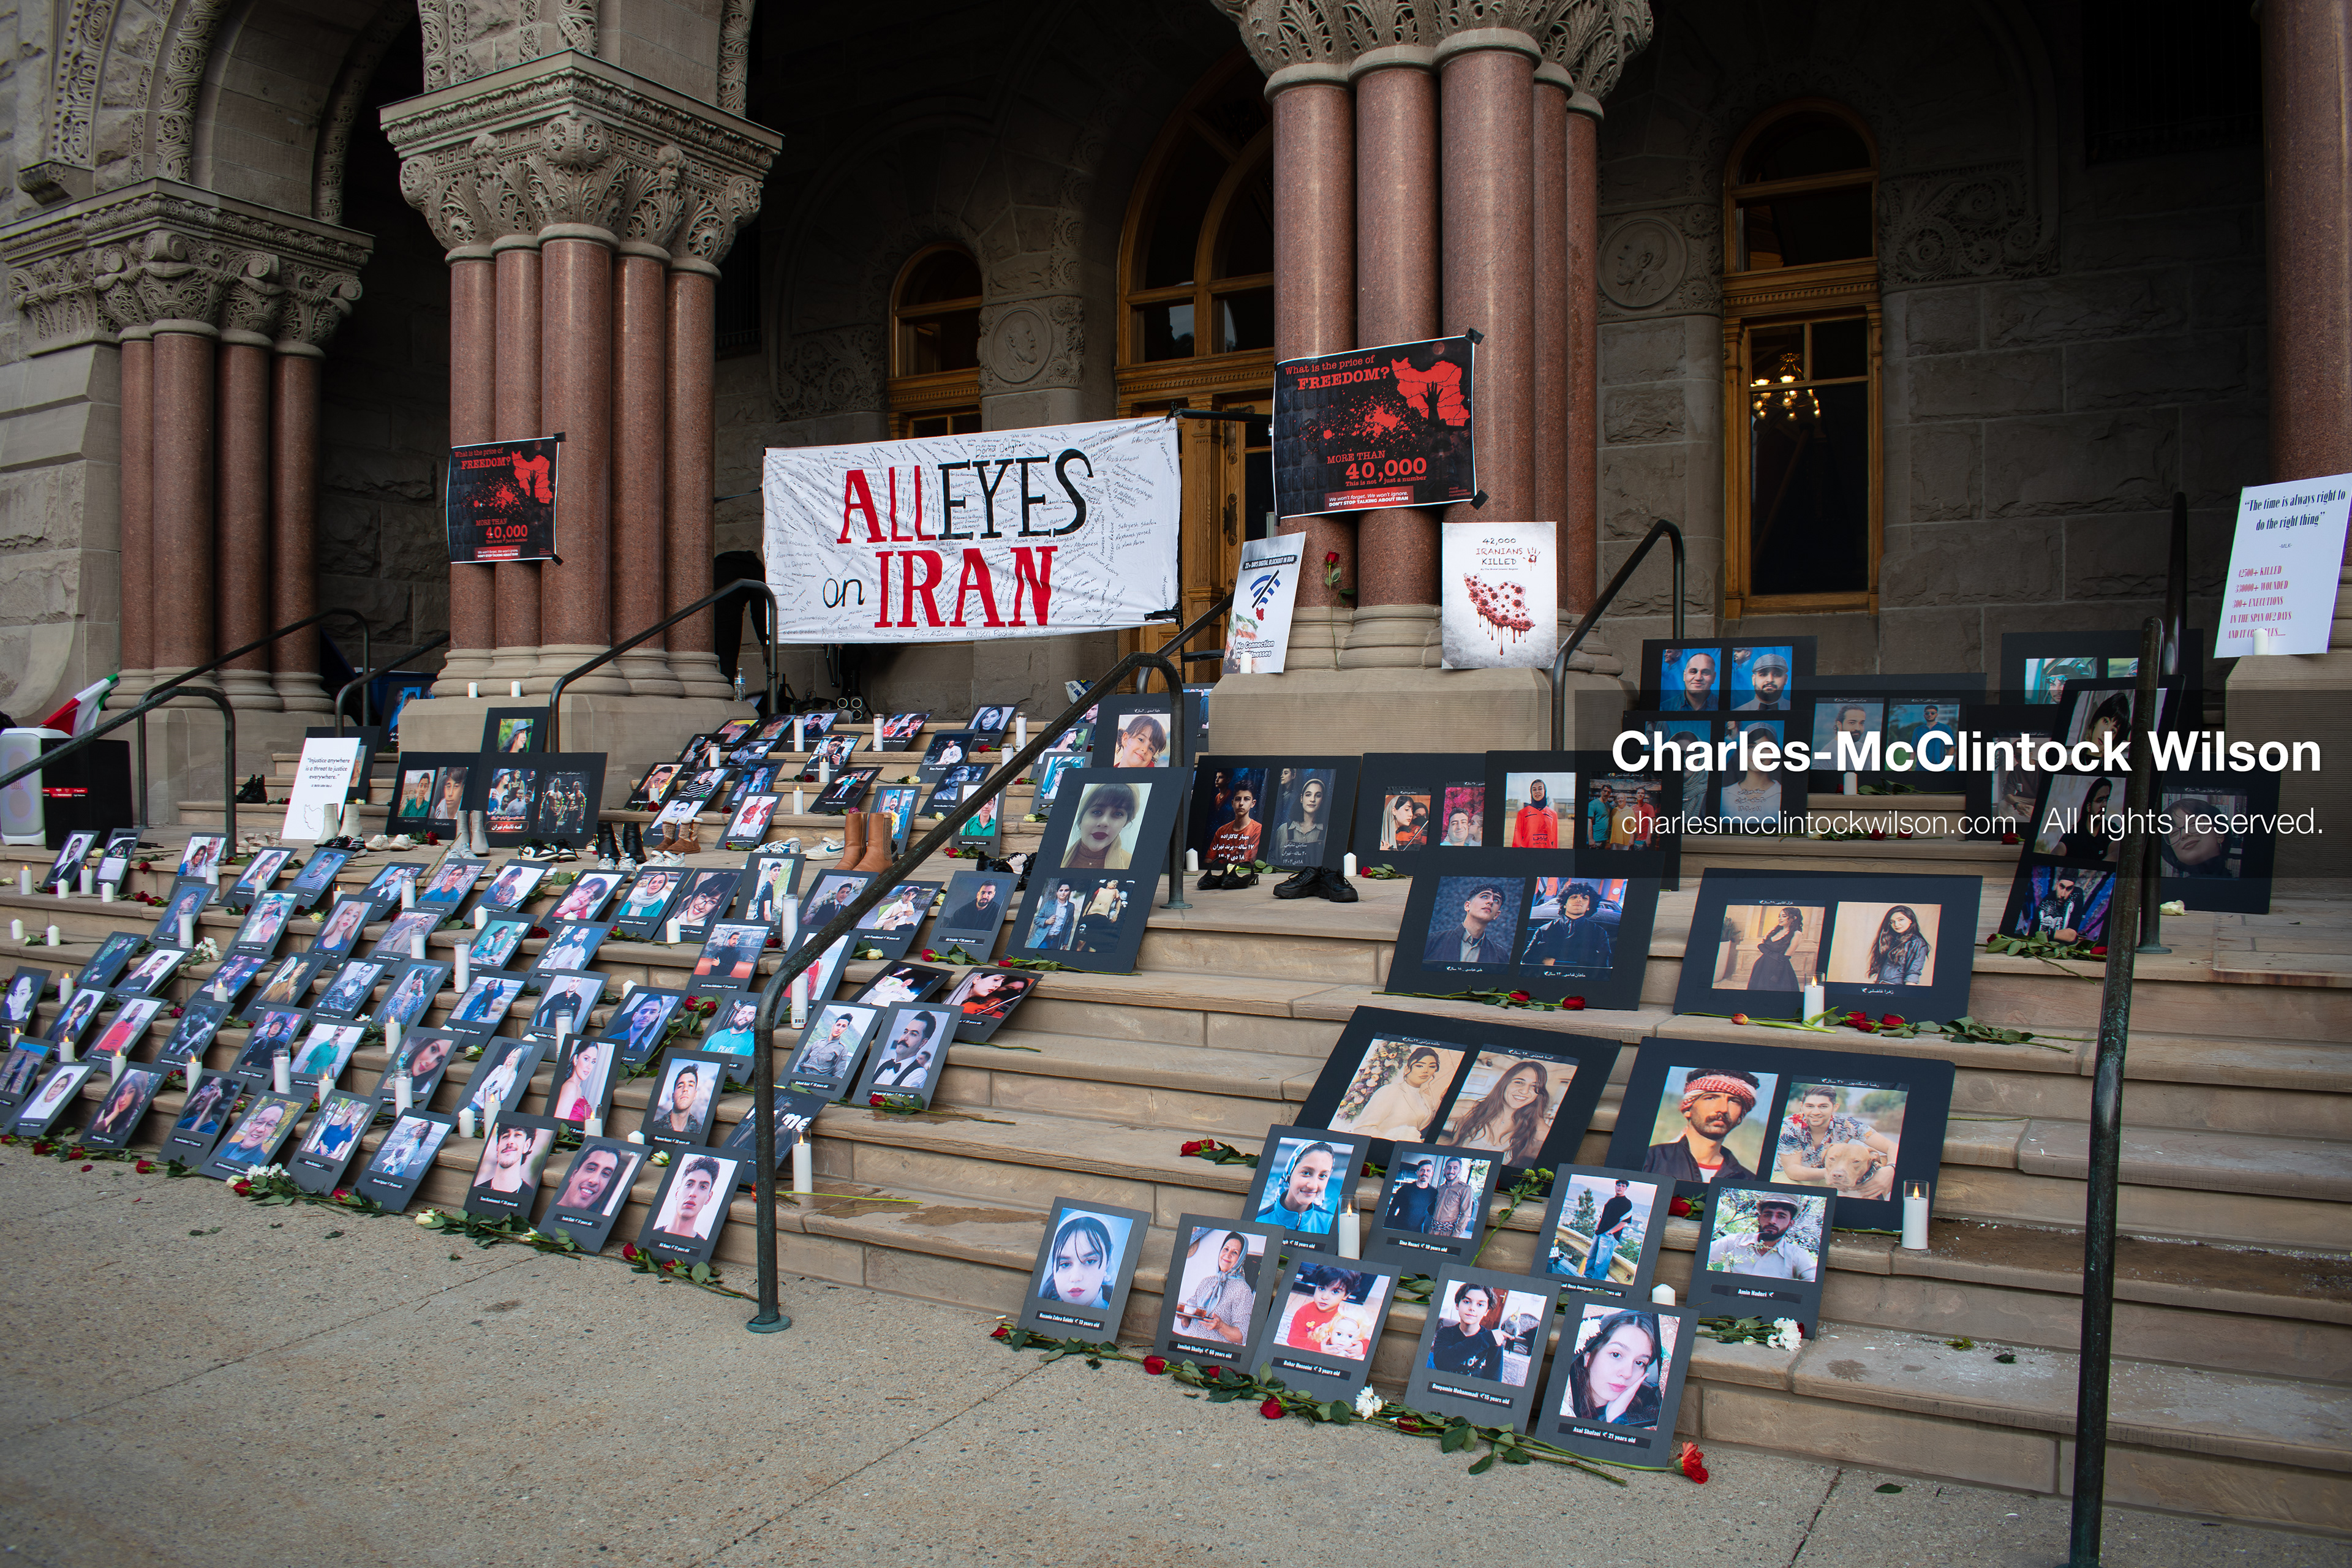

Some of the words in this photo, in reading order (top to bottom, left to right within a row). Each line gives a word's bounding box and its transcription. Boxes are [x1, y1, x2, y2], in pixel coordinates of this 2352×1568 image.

[1285, 364, 1309, 375] What
[1322, 362, 1337, 371] the
[1339, 358, 1363, 369] price
[1365, 355, 1376, 364] of
[1297, 366, 1390, 390] FREEDOM?
[461, 456, 511, 470] FREEDOM?
[1327, 453, 1355, 464] MORE
[1357, 450, 1385, 460] THAN
[1345, 457, 1427, 482] 40,000
[837, 464, 937, 544] ALL
[938, 448, 1095, 541] EYES
[2245, 499, 2262, 511] “The
[2264, 497, 2280, 510] time
[2282, 496, 2288, 507] is
[2290, 494, 2315, 507] always
[2316, 491, 2335, 505] right
[2337, 489, 2345, 500] to
[2256, 519, 2264, 531] do
[2266, 518, 2278, 530] the
[2279, 516, 2298, 530] right
[2299, 511, 2326, 527] thing”
[486, 524, 527, 541] 40,000
[2238, 568, 2259, 578] 42500+
[2260, 565, 2282, 576] KILLED
[823, 577, 868, 609] on
[875, 545, 1058, 628] IRAN
[2234, 583, 2259, 593] 330000+
[2260, 580, 2289, 591] WOUNDED
[2232, 598, 2247, 609] 300+
[2248, 596, 2283, 608] EXECUTIONS
[2230, 614, 2237, 624] IN
[2238, 613, 2249, 624] THE
[2250, 612, 2265, 623] SPAN
[2277, 611, 2292, 621] DAYS
[2227, 629, 2239, 639] AND
[2239, 628, 2246, 638] IT
[1245, 639, 1275, 649] Connection
[1295, 1362, 1313, 1371] Hosseini
[1453, 1387, 1479, 1398] Mohammadi
[1490, 1395, 1502, 1404] years
[1584, 1428, 1600, 1437] Shafaei
